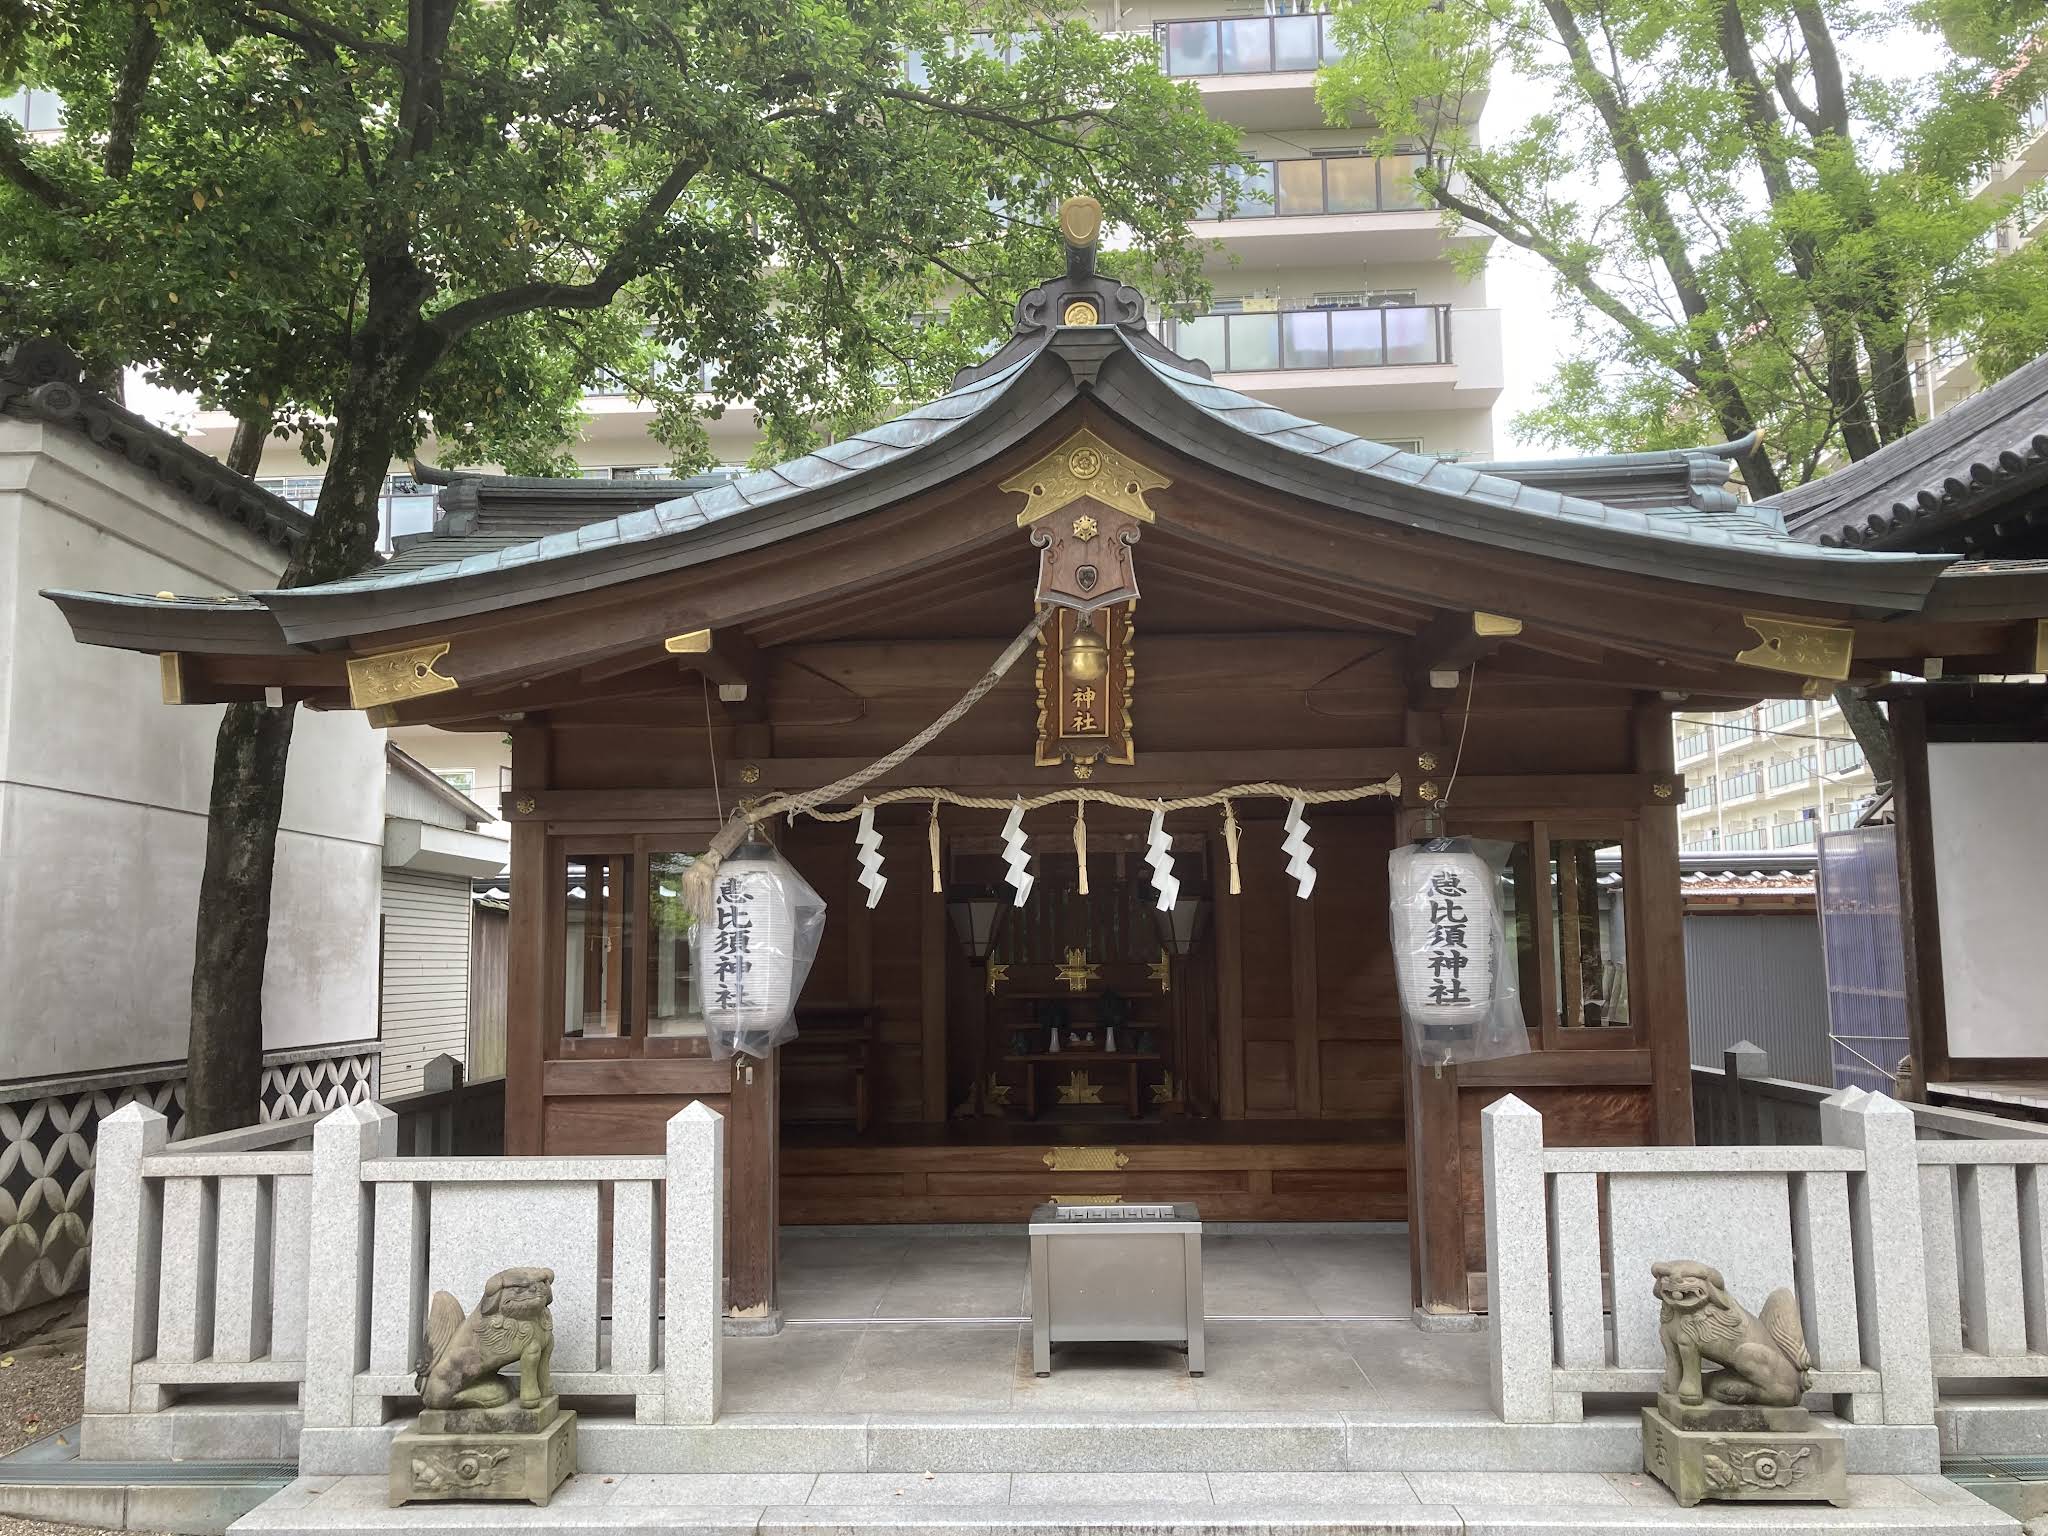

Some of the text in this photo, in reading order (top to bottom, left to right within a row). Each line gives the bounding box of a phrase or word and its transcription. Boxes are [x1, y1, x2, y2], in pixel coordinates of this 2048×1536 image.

[1072, 687, 1097, 732] 神社
[713, 877, 755, 1009] 恵比須神社
[1426, 870, 1471, 1005] 恵比須神社
